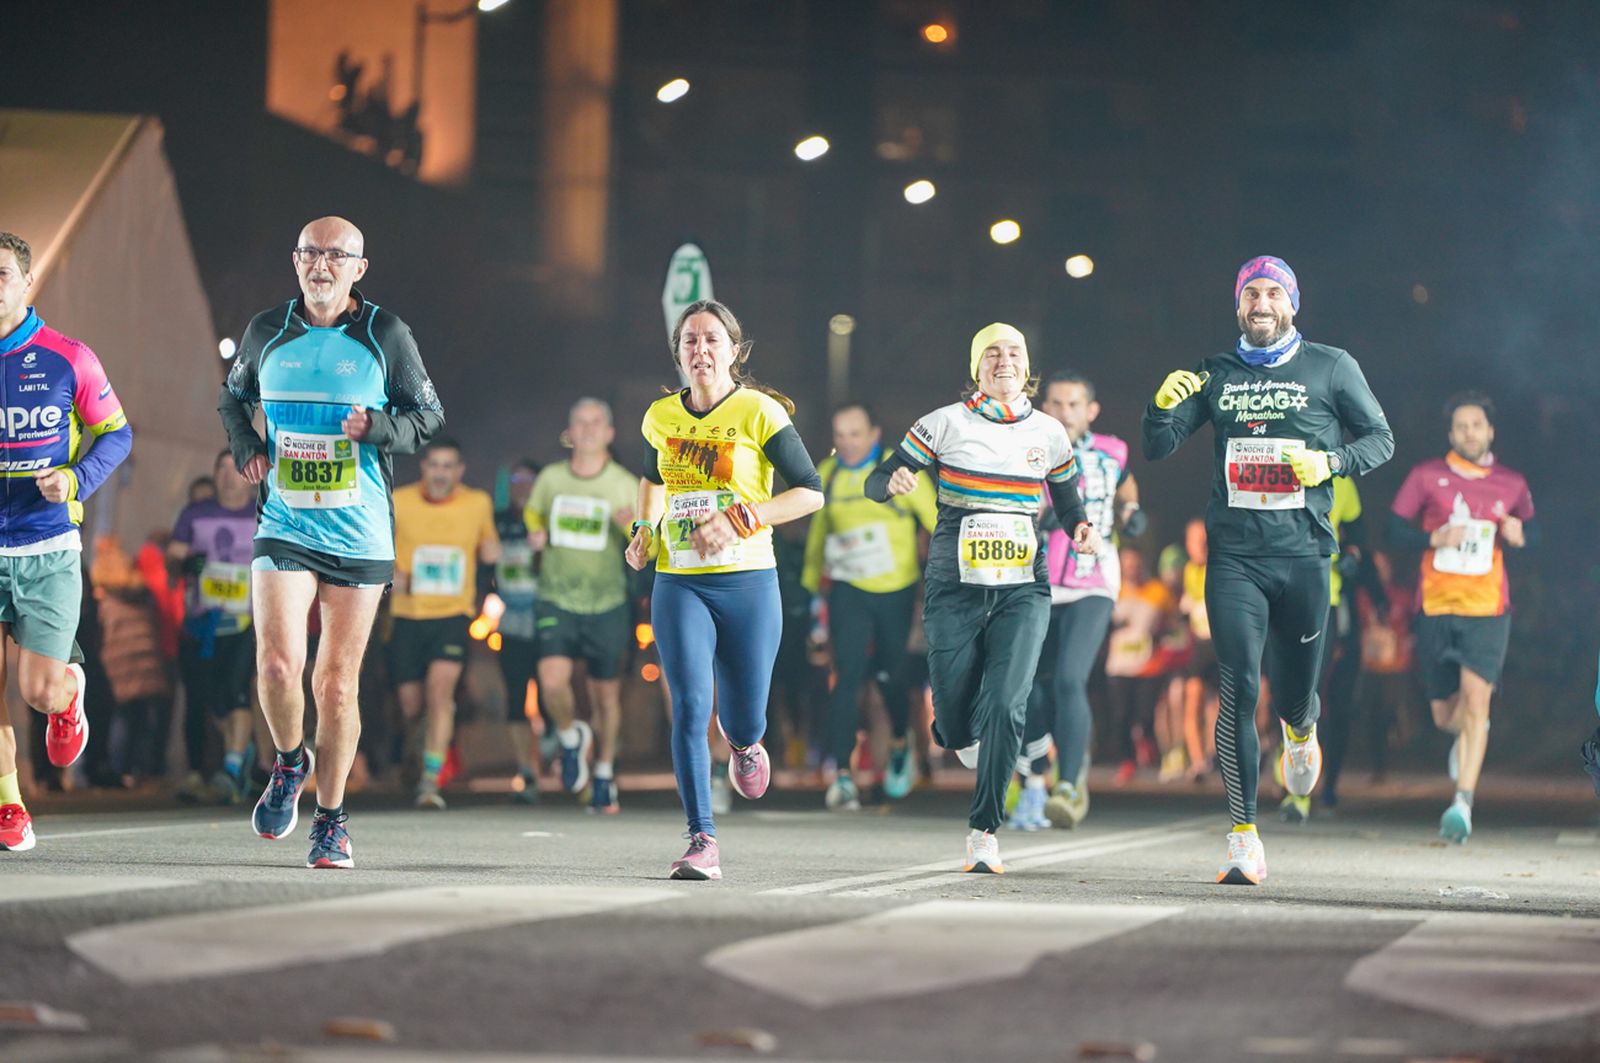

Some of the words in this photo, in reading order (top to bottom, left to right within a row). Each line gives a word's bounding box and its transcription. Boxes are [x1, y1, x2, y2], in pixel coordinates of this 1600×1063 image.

[1223, 382, 1249, 395] Bank
[1250, 381, 1261, 392] of
[1262, 380, 1306, 393] America
[1235, 410, 1285, 422] Marathon
[1252, 424, 1267, 435] 24
[292, 442, 316, 450] NOCHE
[317, 443, 327, 451] DE
[284, 449, 299, 458] SAN
[291, 460, 343, 483] 8837
[1236, 463, 1293, 485] 13755
[968, 540, 1028, 560] 13889
